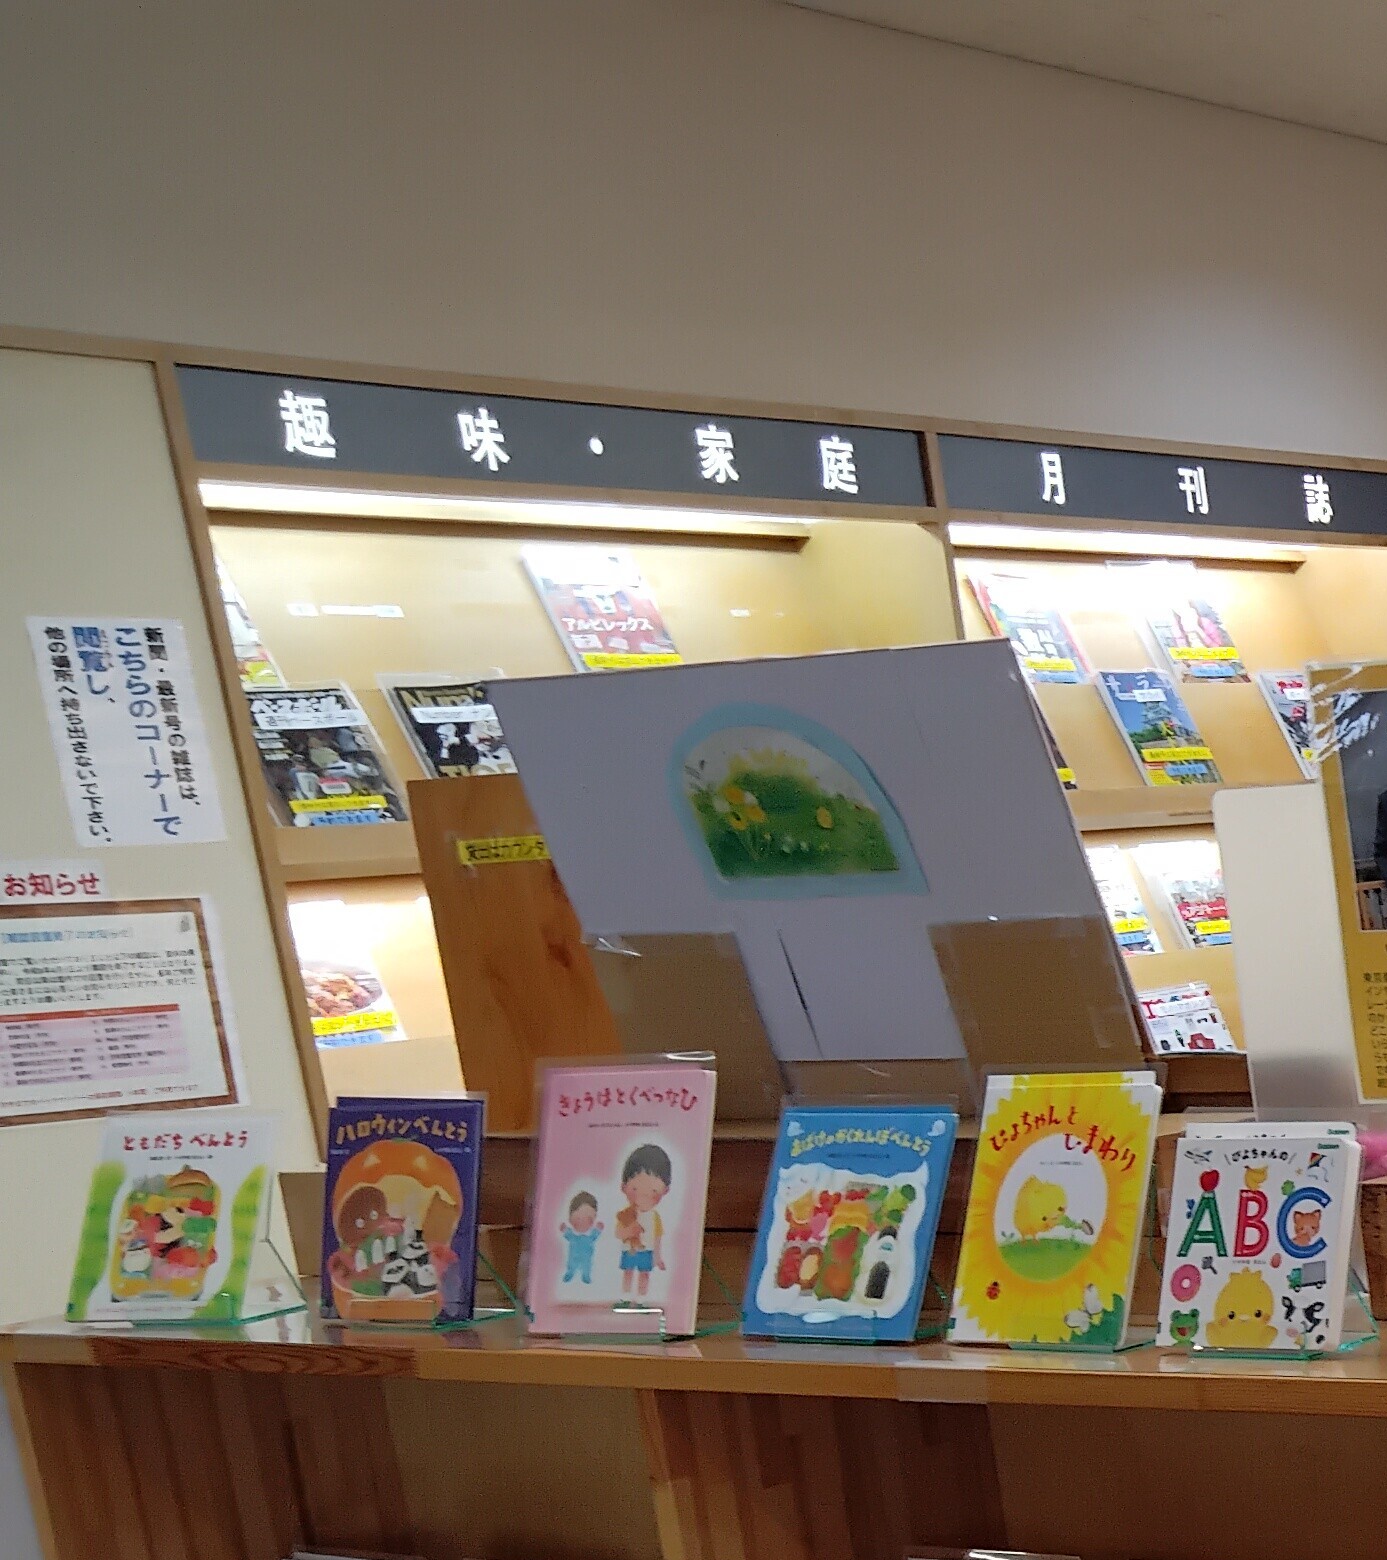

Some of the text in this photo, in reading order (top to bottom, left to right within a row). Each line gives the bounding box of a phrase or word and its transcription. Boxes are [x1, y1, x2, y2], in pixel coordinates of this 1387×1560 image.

[278, 388, 861, 496] 趣味・家庭
[1040, 451, 1335, 525] 月刊誌
[114, 627, 182, 836] こちらのコーナーで
[4, 873, 101, 897] お知らせ
[989, 1105, 1080, 1152] ぴよちゃんと
[1176, 1185, 1333, 1259] ABC
